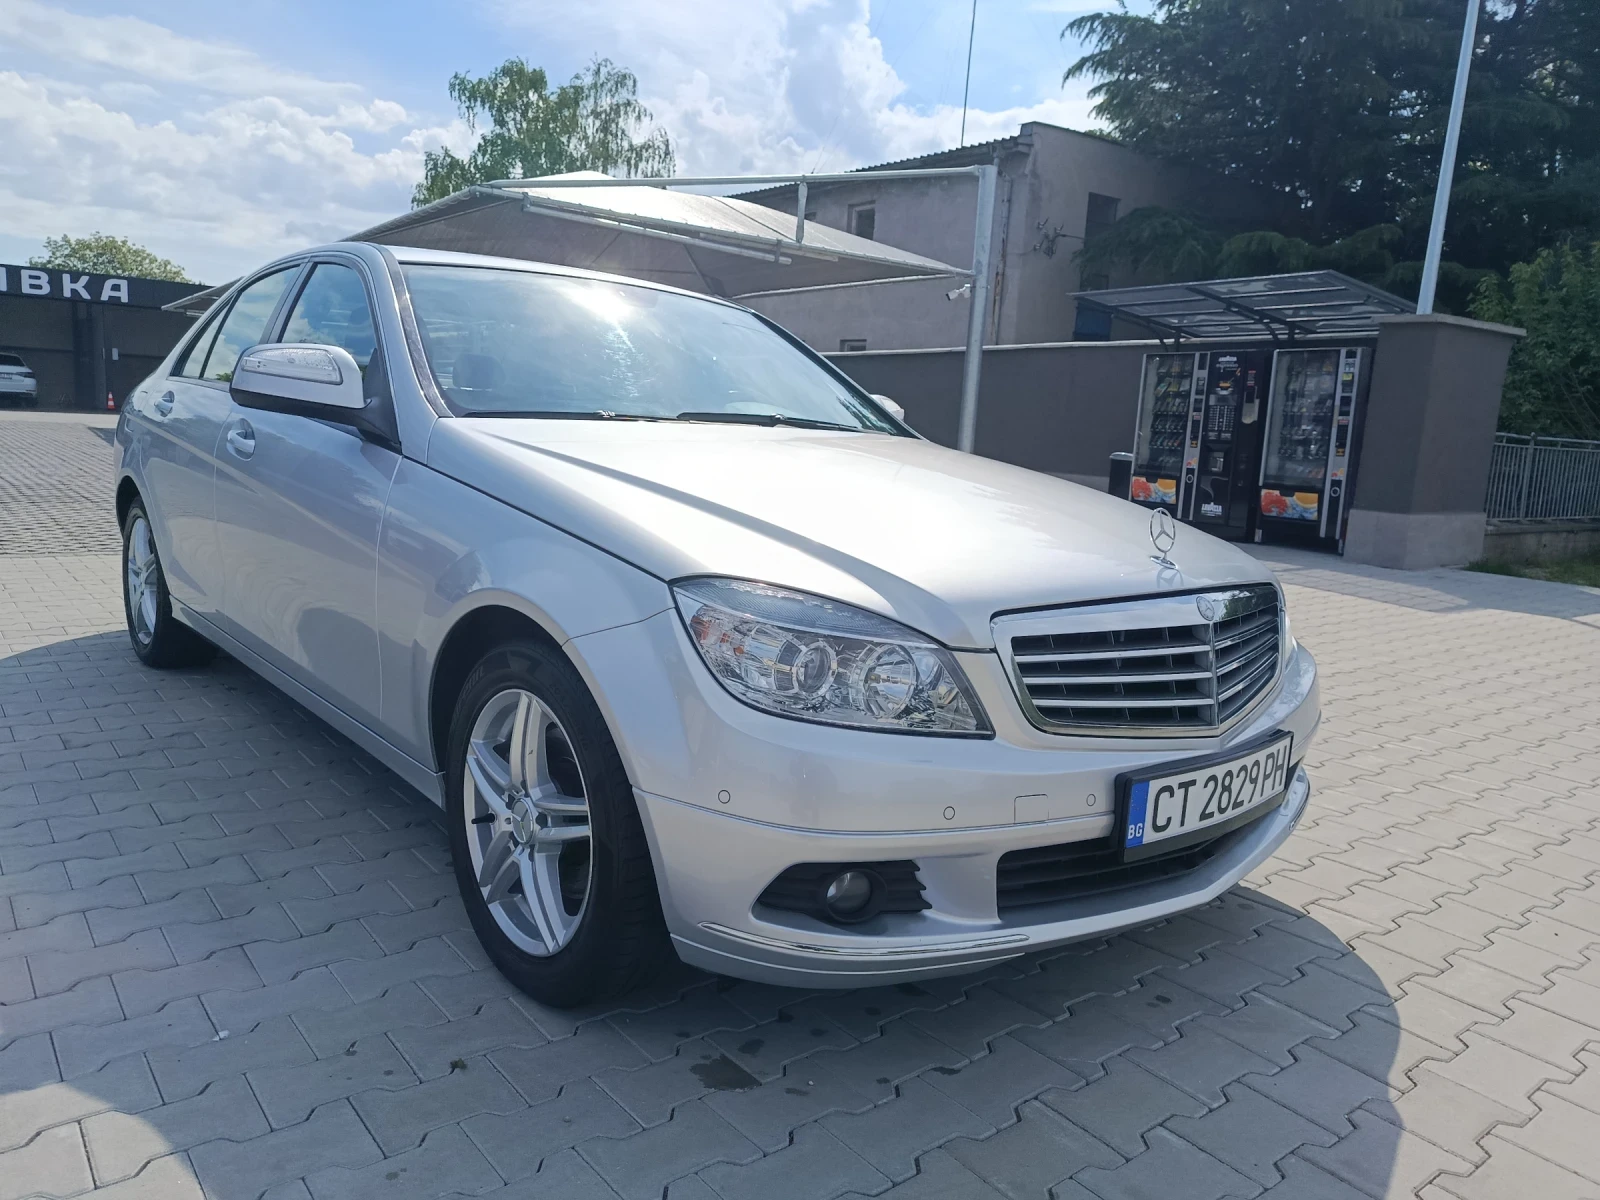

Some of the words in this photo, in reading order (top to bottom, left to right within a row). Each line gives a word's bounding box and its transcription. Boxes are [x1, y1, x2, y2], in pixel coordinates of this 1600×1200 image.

[0, 266, 129, 303] ВКА
[1152, 779, 1197, 833] CT
[1199, 759, 1261, 822] 2829
[1260, 745, 1287, 798] PH
[1127, 822, 1144, 840] BG
